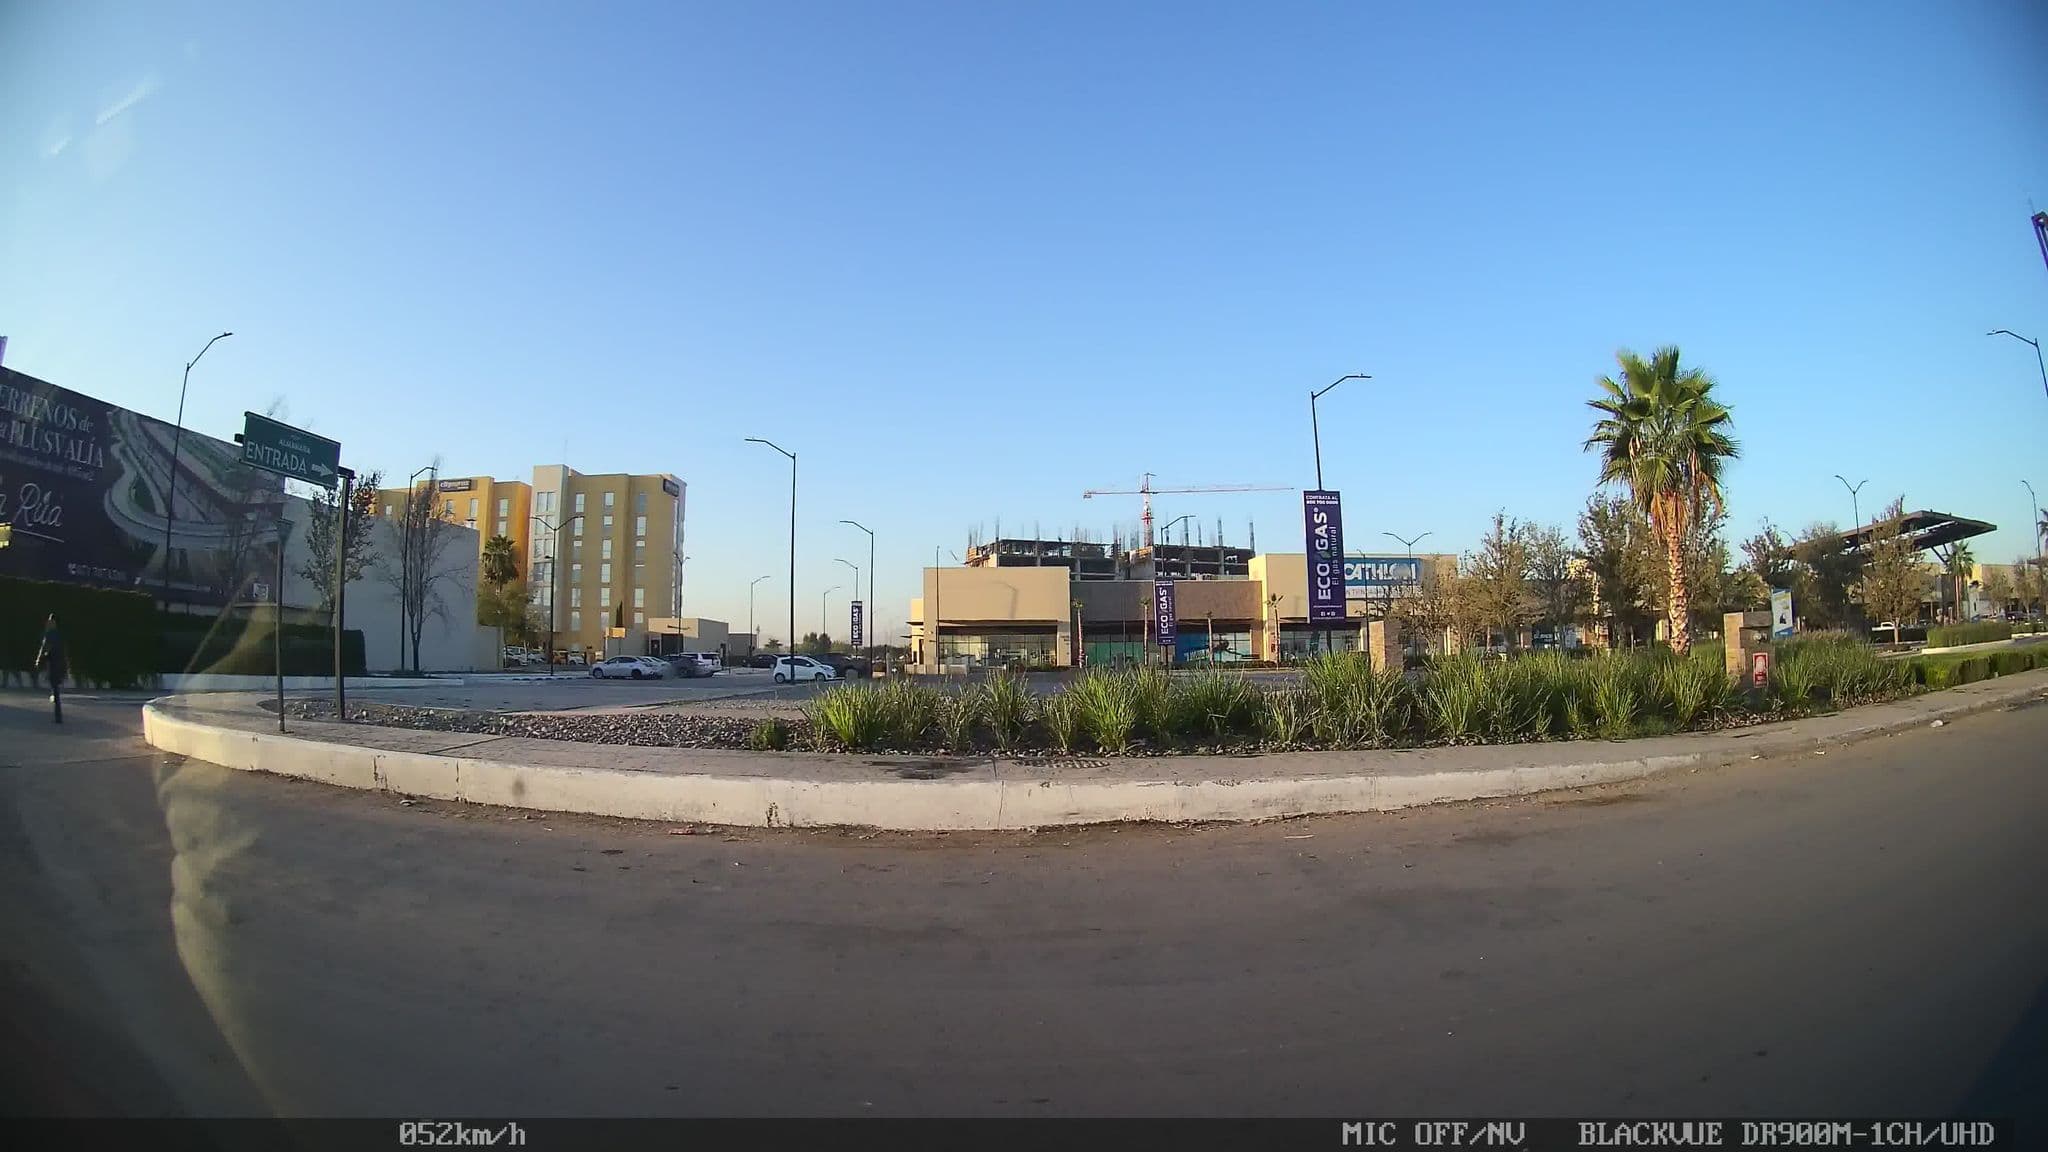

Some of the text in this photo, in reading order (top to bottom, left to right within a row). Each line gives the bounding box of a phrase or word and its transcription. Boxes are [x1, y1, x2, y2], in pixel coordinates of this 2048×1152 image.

[79, 415, 95, 433] de
[246, 441, 308, 475] ENTRADA
[12, 483, 63, 527] Rúa
[1313, 511, 1328, 550] GAS
[1329, 526, 1338, 557] natural
[1317, 563, 1331, 600] ECO
[1332, 559, 1341, 575] gas
[1160, 589, 1168, 610] GAS
[1160, 615, 1168, 634] ECO
